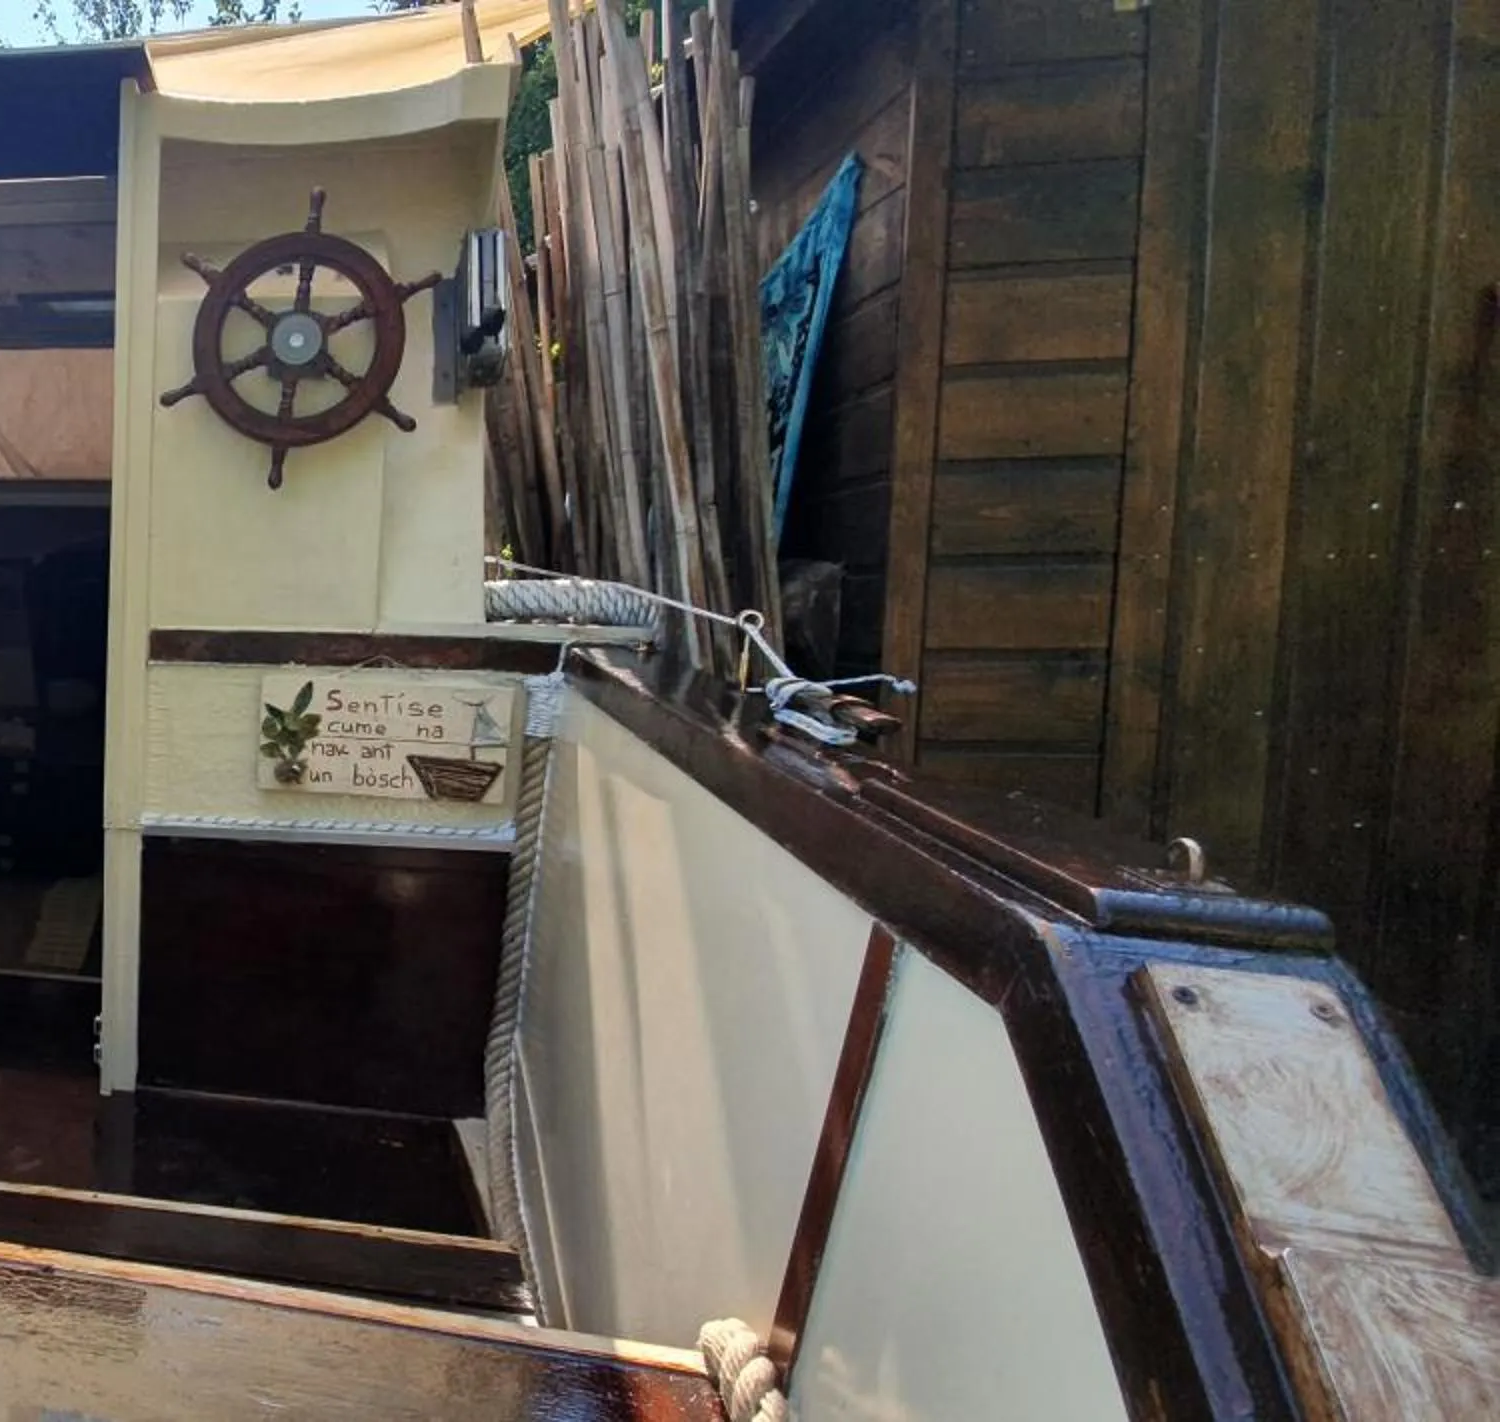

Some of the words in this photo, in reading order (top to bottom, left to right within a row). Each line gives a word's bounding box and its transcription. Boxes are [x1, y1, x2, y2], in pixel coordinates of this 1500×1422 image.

[327, 720, 388, 736] cume
[417, 723, 444, 739] na
[309, 768, 333, 783] un
